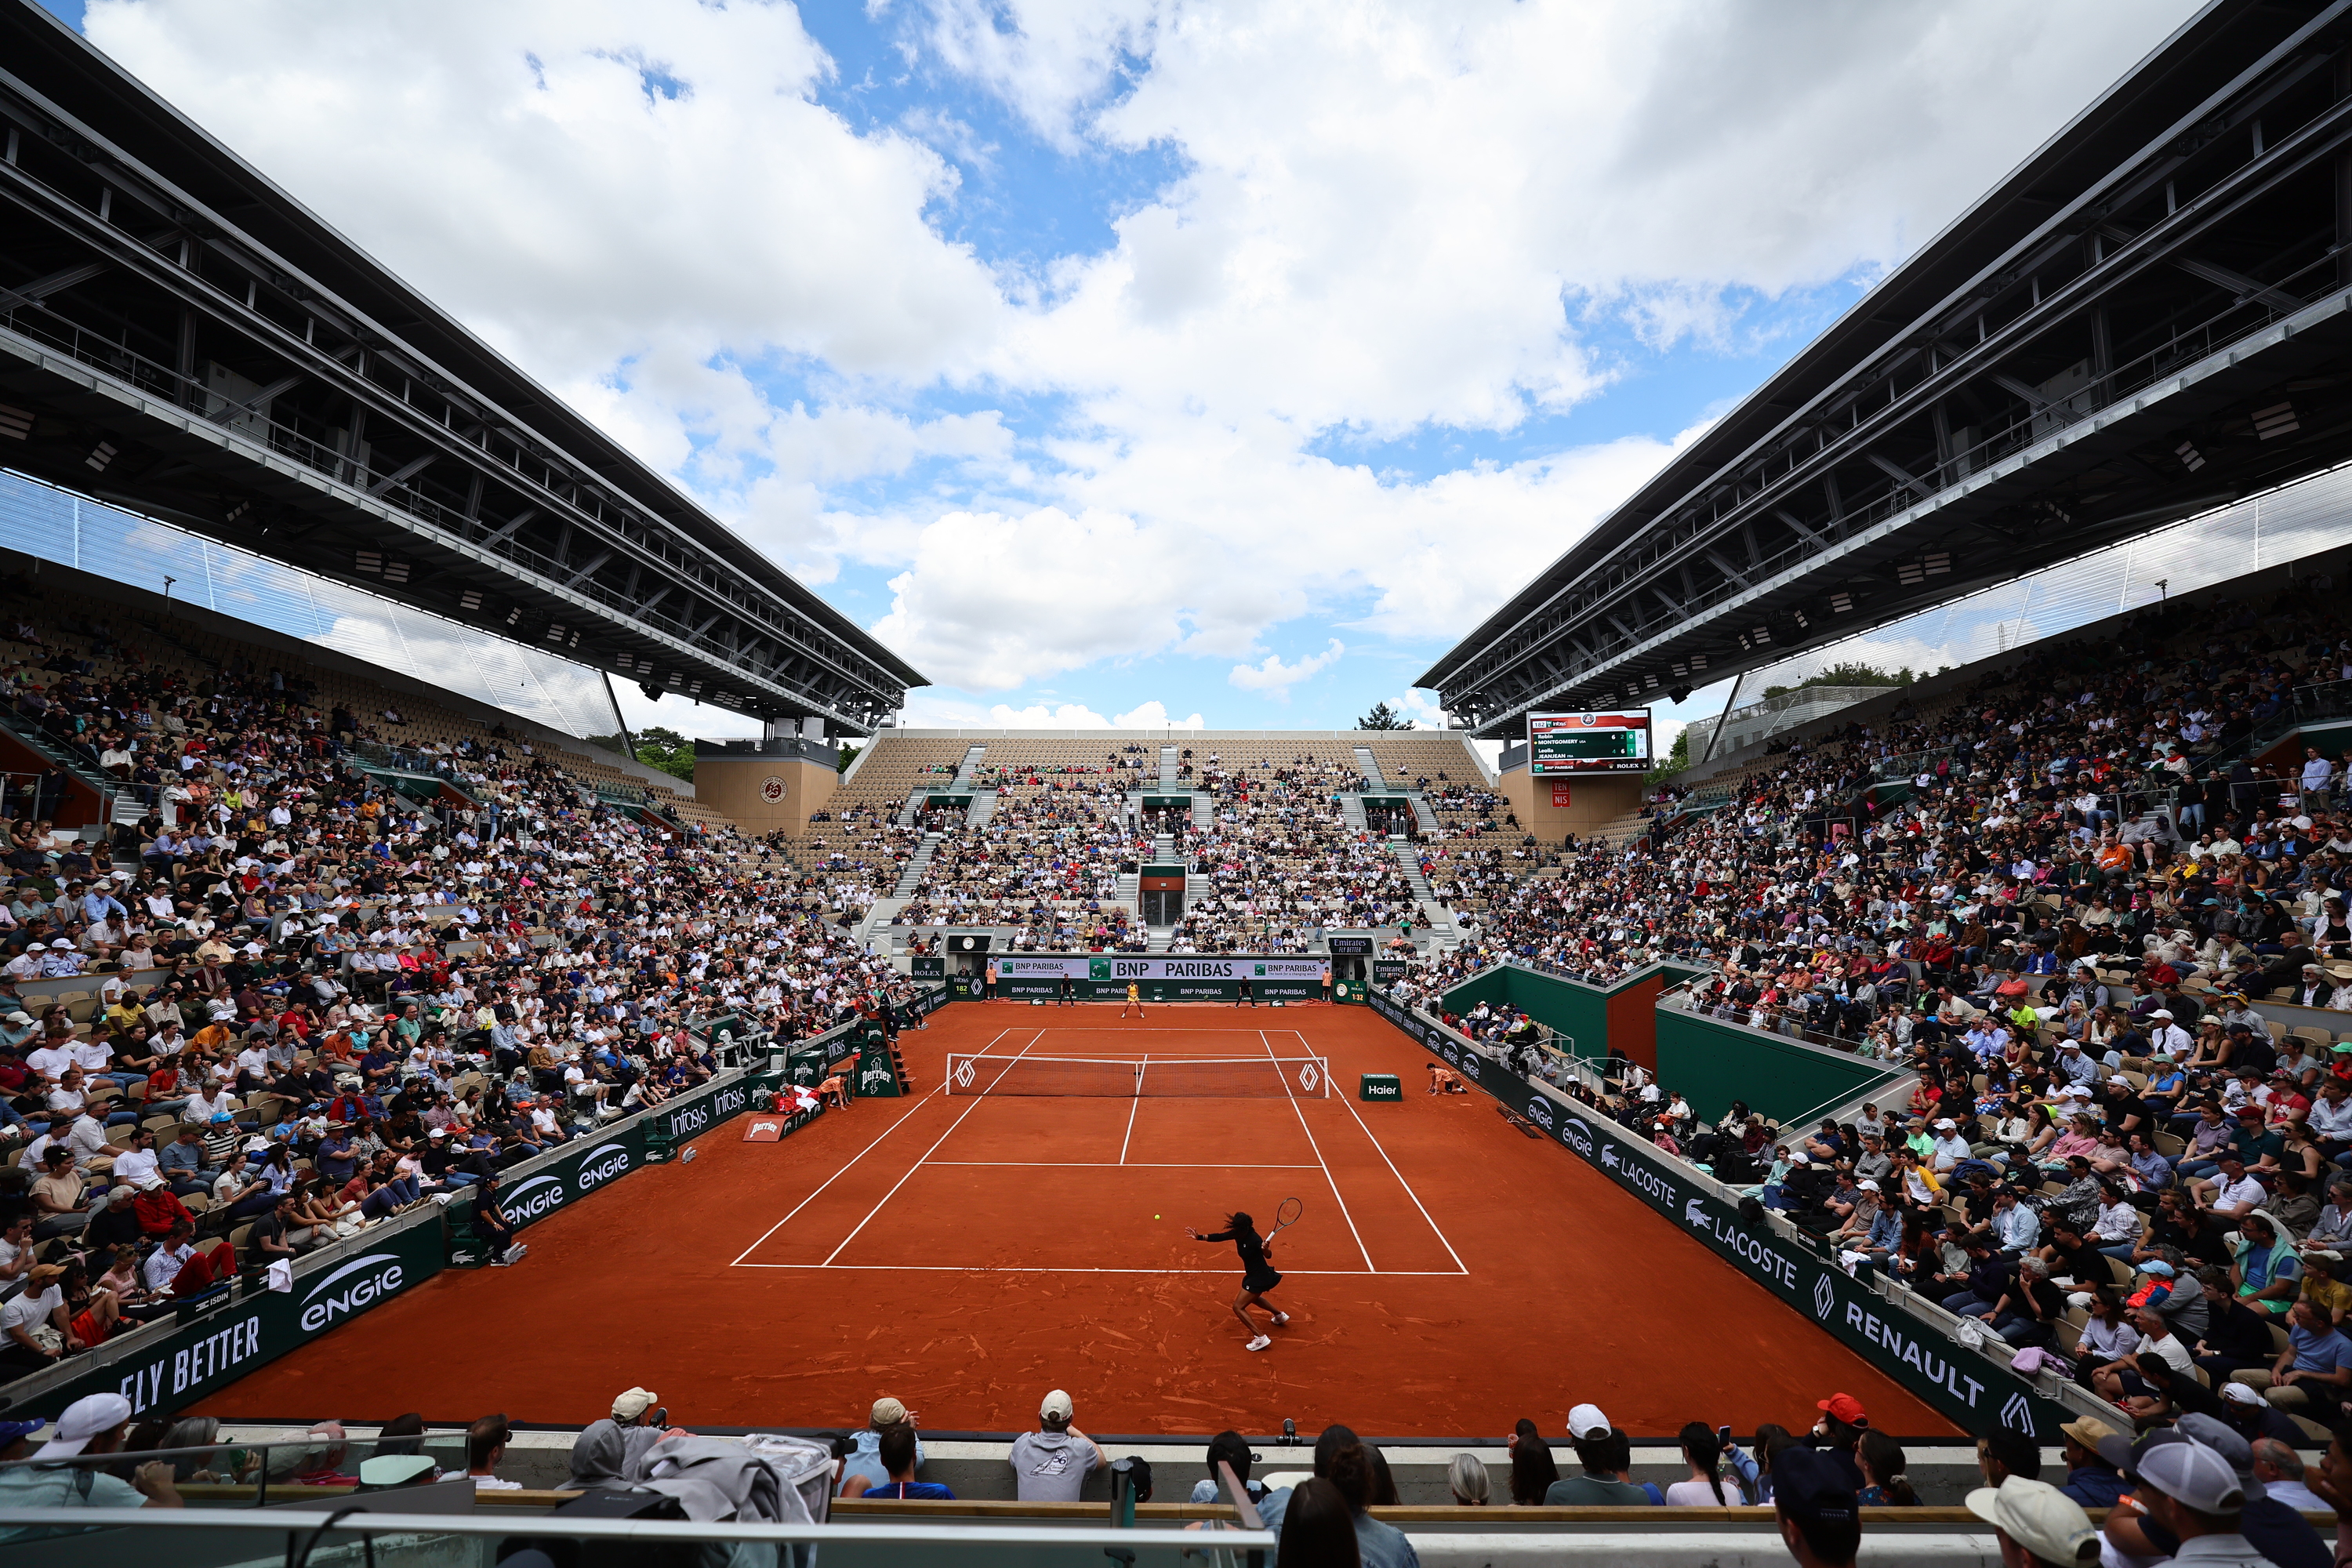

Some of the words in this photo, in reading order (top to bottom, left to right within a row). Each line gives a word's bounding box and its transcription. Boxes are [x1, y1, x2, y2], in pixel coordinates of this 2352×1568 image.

[761, 778, 773, 793] ROLAND
[775, 778, 786, 793] GARROS
[1117, 962, 1149, 976] BNP
[1165, 963, 1232, 977] PARIBAS
[933, 992, 946, 1004] RENAULT
[827, 1039, 845, 1058] Infosys
[1369, 1085, 1396, 1094] Haier
[714, 1086, 745, 1117] Infosys
[670, 1104, 707, 1138] Infosys
[1621, 1157, 1676, 1208] LACOSTE
[1714, 1217, 1798, 1290] LACOSTE
[210, 1291, 229, 1306] ISDIN
[1846, 1300, 1985, 1408] RENAULT
[121, 1359, 164, 1415] FLY
[173, 1315, 259, 1396] BETTER
[1054, 1455, 1066, 1465] 56
